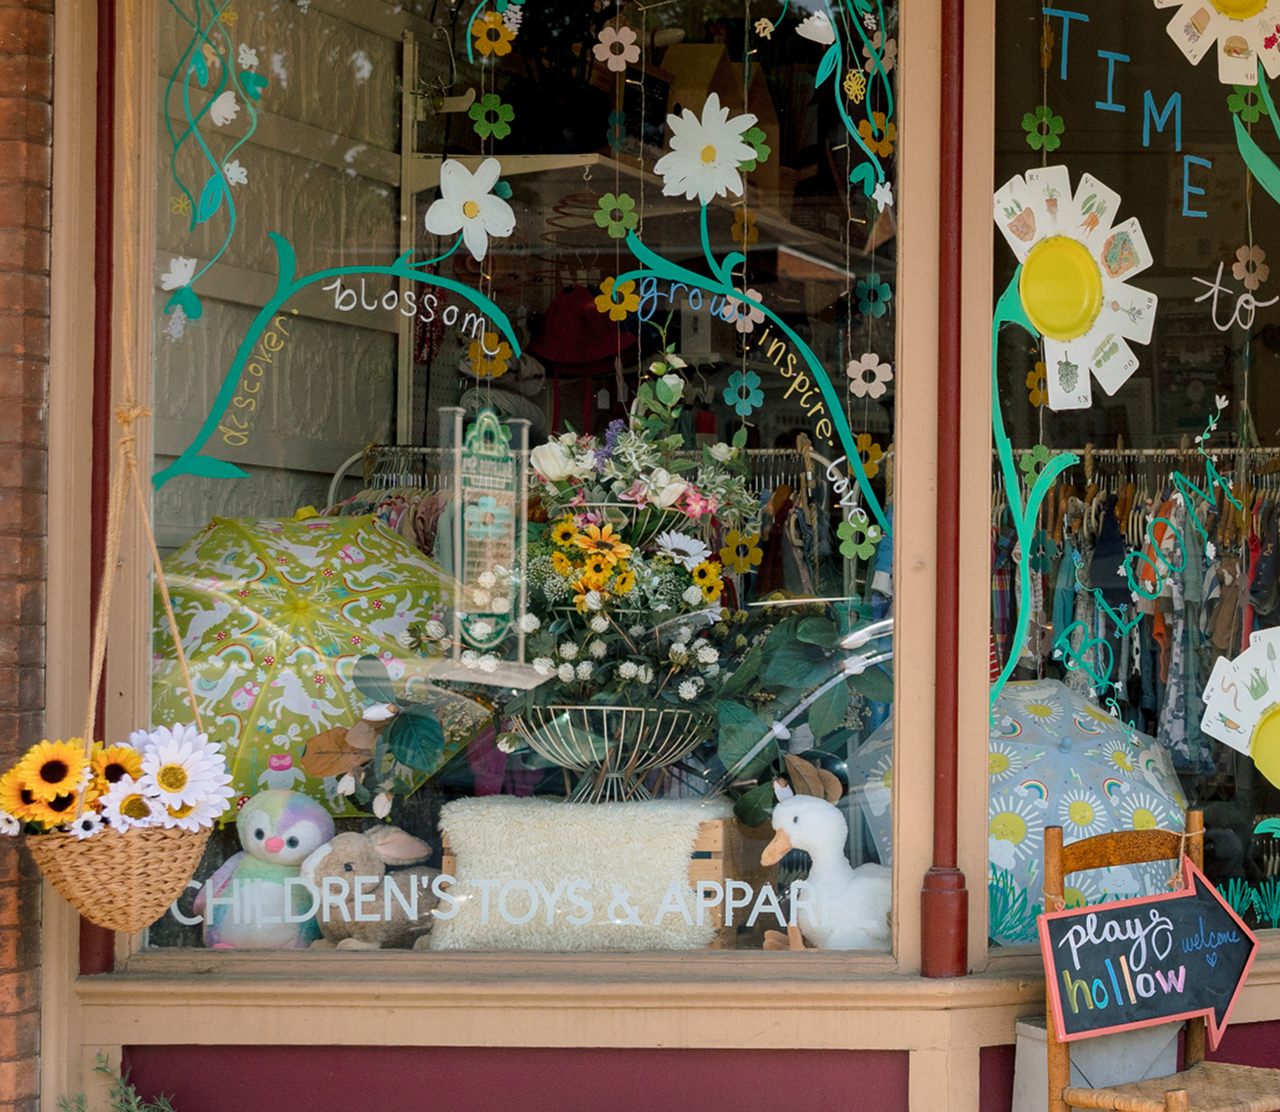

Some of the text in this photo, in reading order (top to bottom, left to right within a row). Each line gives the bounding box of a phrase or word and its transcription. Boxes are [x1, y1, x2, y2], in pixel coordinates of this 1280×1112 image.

[1042, 7, 1212, 218] TIME
[322, 278, 500, 355] blossom
[1192, 261, 1280, 331] to
[826, 455, 868, 528] love
[170, 874, 460, 926] CHILDREN'S
[471, 878, 594, 927] TOYS
[607, 883, 644, 927] &
[1058, 911, 1242, 972] play welcome
[1062, 955, 1187, 1014] hollow
